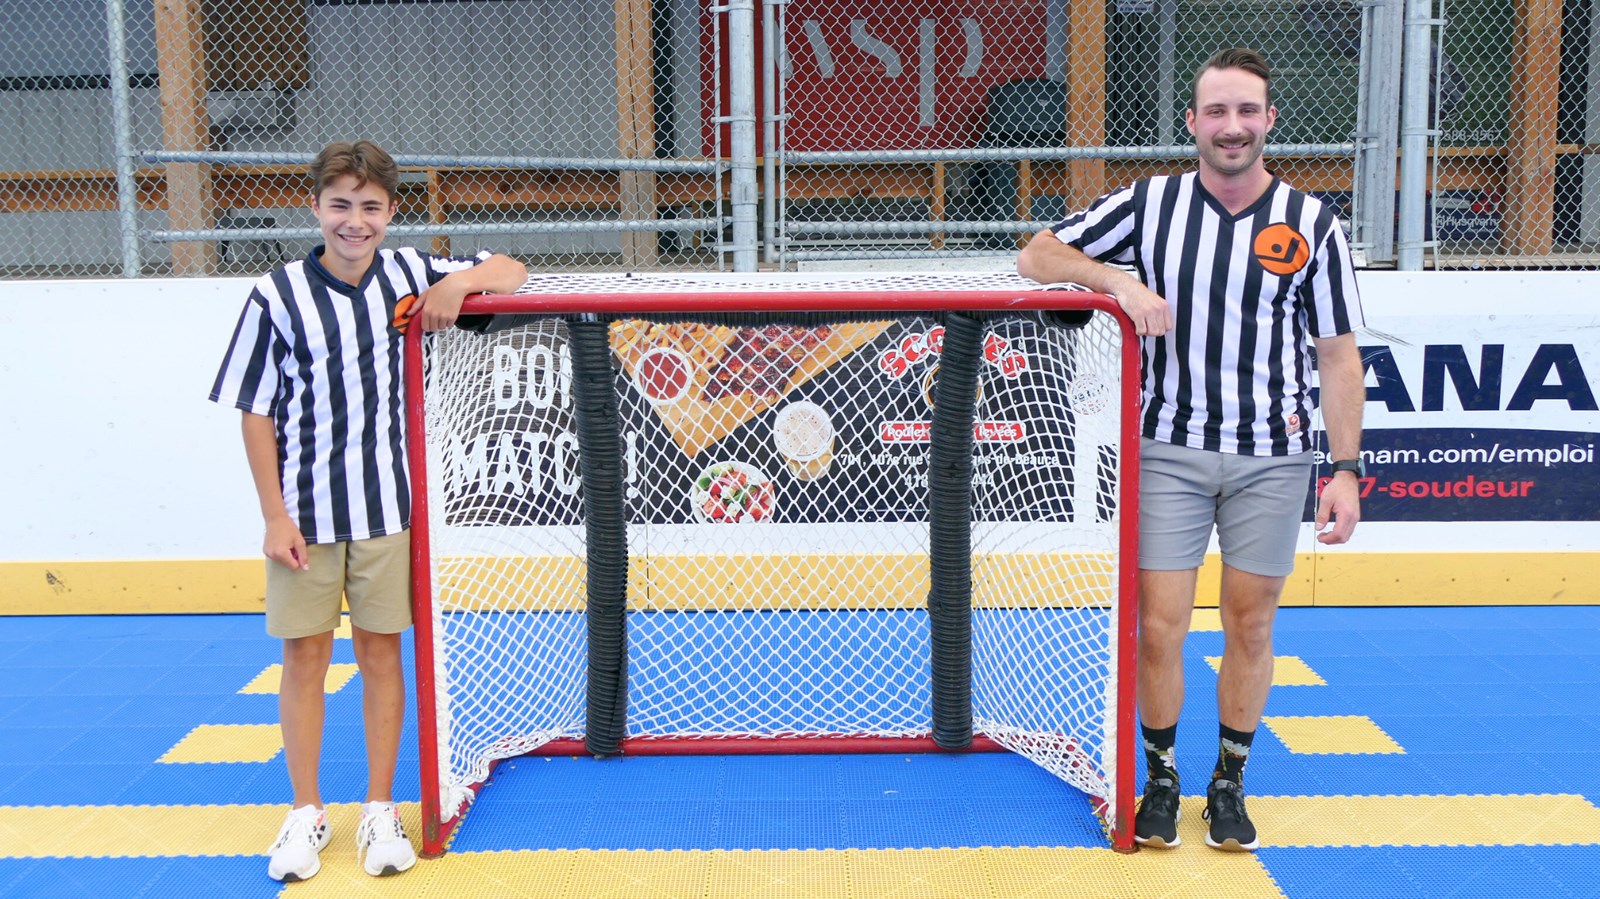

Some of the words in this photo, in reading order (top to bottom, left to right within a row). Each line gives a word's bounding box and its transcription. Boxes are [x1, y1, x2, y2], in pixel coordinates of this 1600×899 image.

[1446, 215, 1499, 228] Husqvarn
[1307, 344, 1600, 413] ANA
[903, 456, 923, 466] rue
